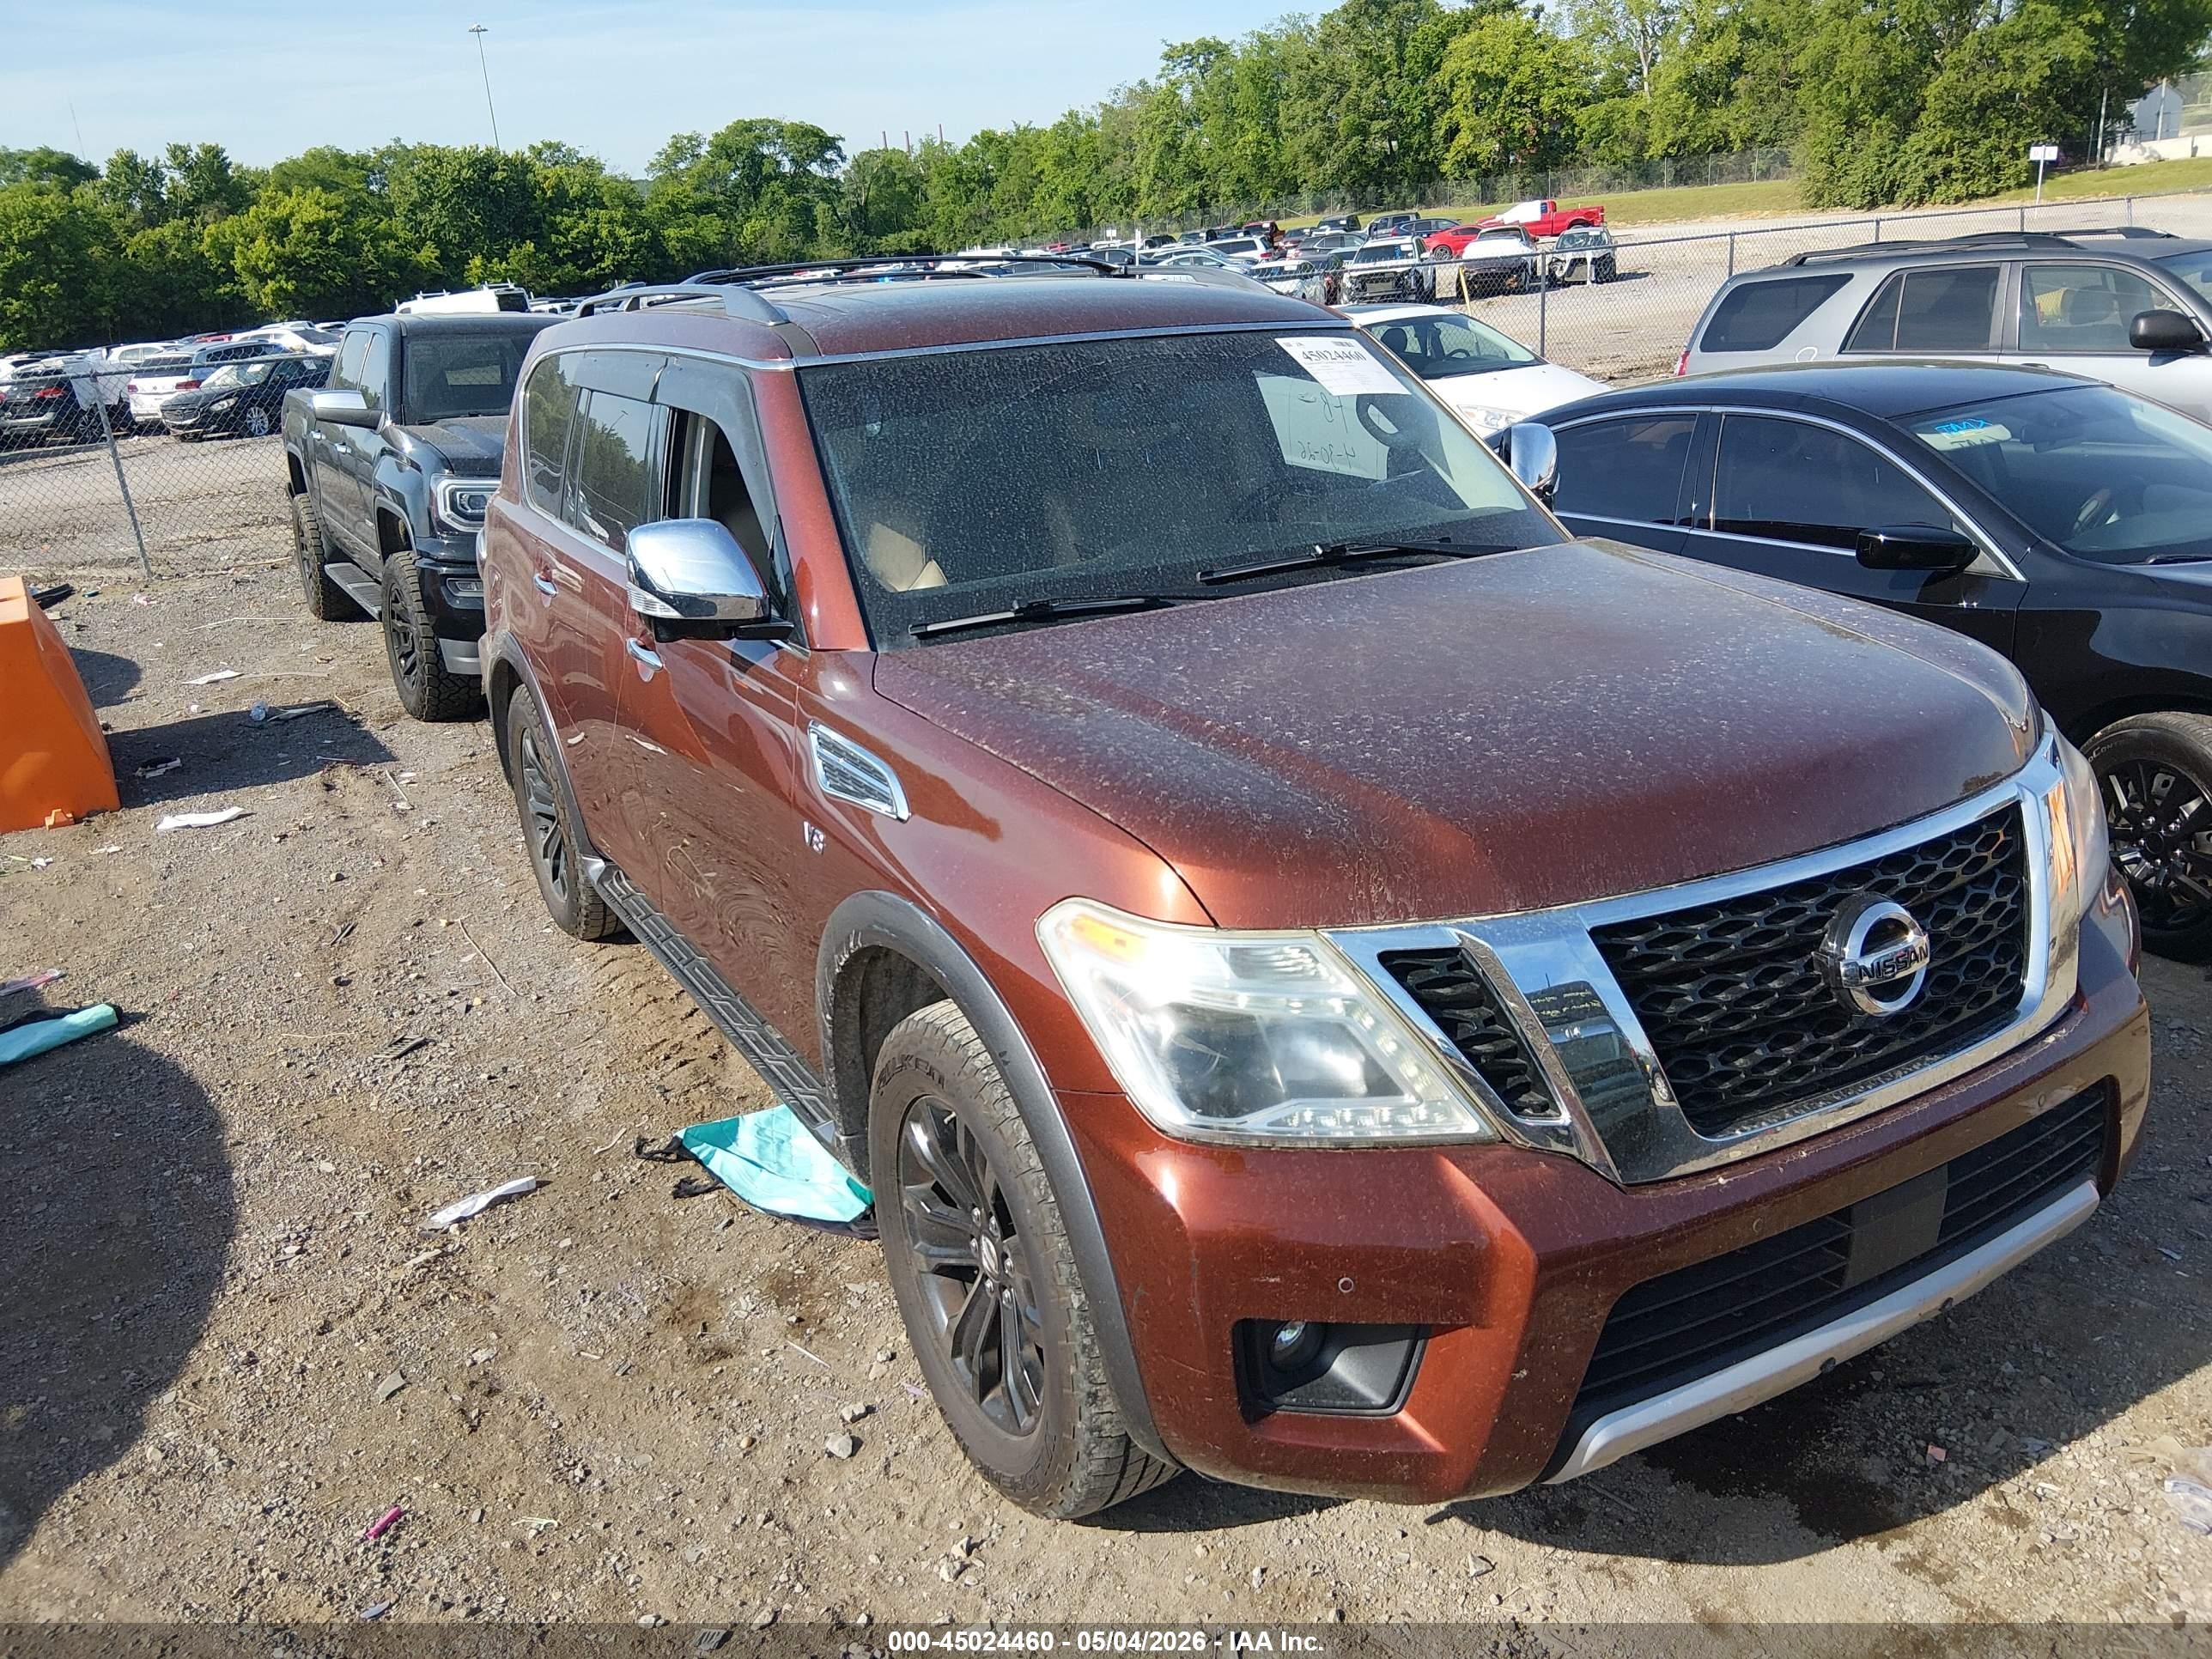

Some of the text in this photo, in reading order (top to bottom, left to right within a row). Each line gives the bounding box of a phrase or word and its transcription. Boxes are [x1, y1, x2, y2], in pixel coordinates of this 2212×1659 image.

[1302, 349, 1367, 362] 45024460
[803, 821, 825, 854] V8
[1857, 944, 1929, 981] NISSAN
